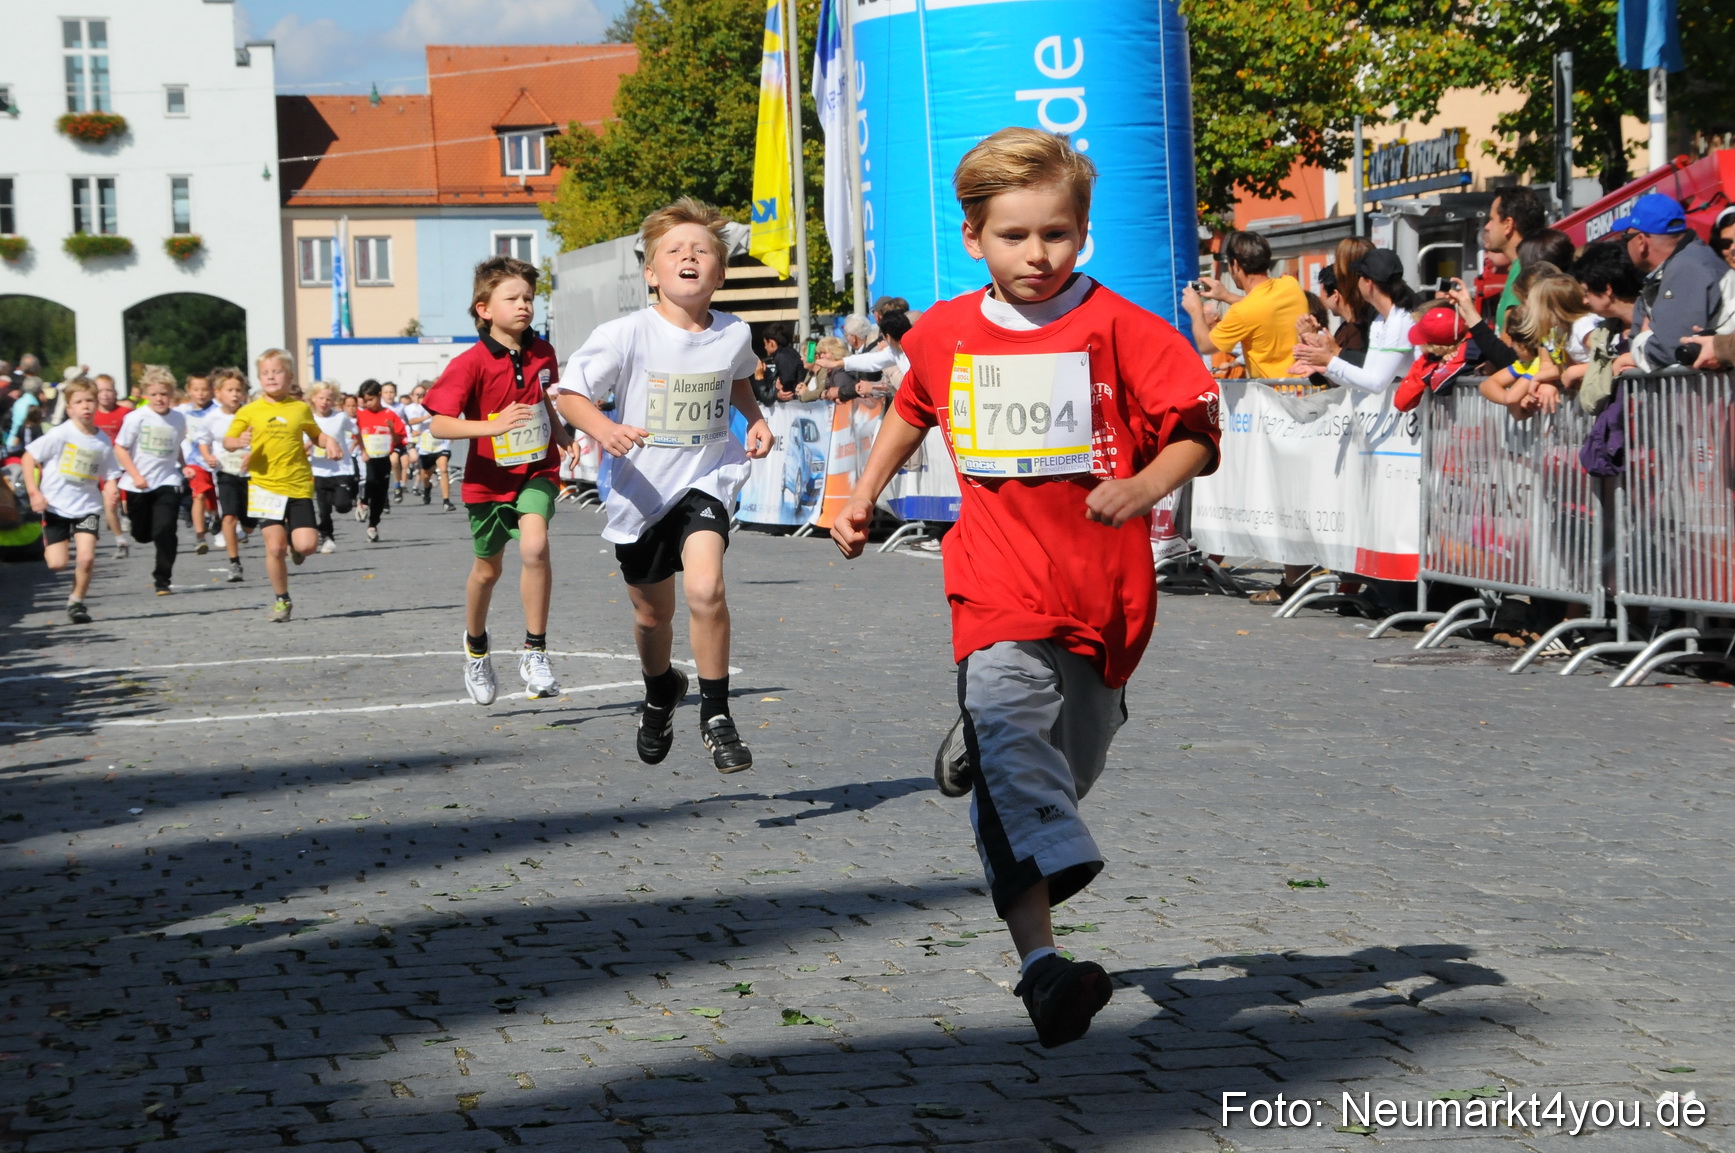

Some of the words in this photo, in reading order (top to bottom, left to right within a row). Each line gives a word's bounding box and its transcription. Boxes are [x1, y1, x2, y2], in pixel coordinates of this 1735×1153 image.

[673, 377, 725, 393] Alexander
[979, 365, 1001, 387] Uli
[673, 398, 725, 422] 7015
[953, 399, 968, 417] K4
[982, 400, 1079, 436] 7094
[511, 423, 549, 447] 7278
[1033, 453, 1091, 468] PFLEIDERER
